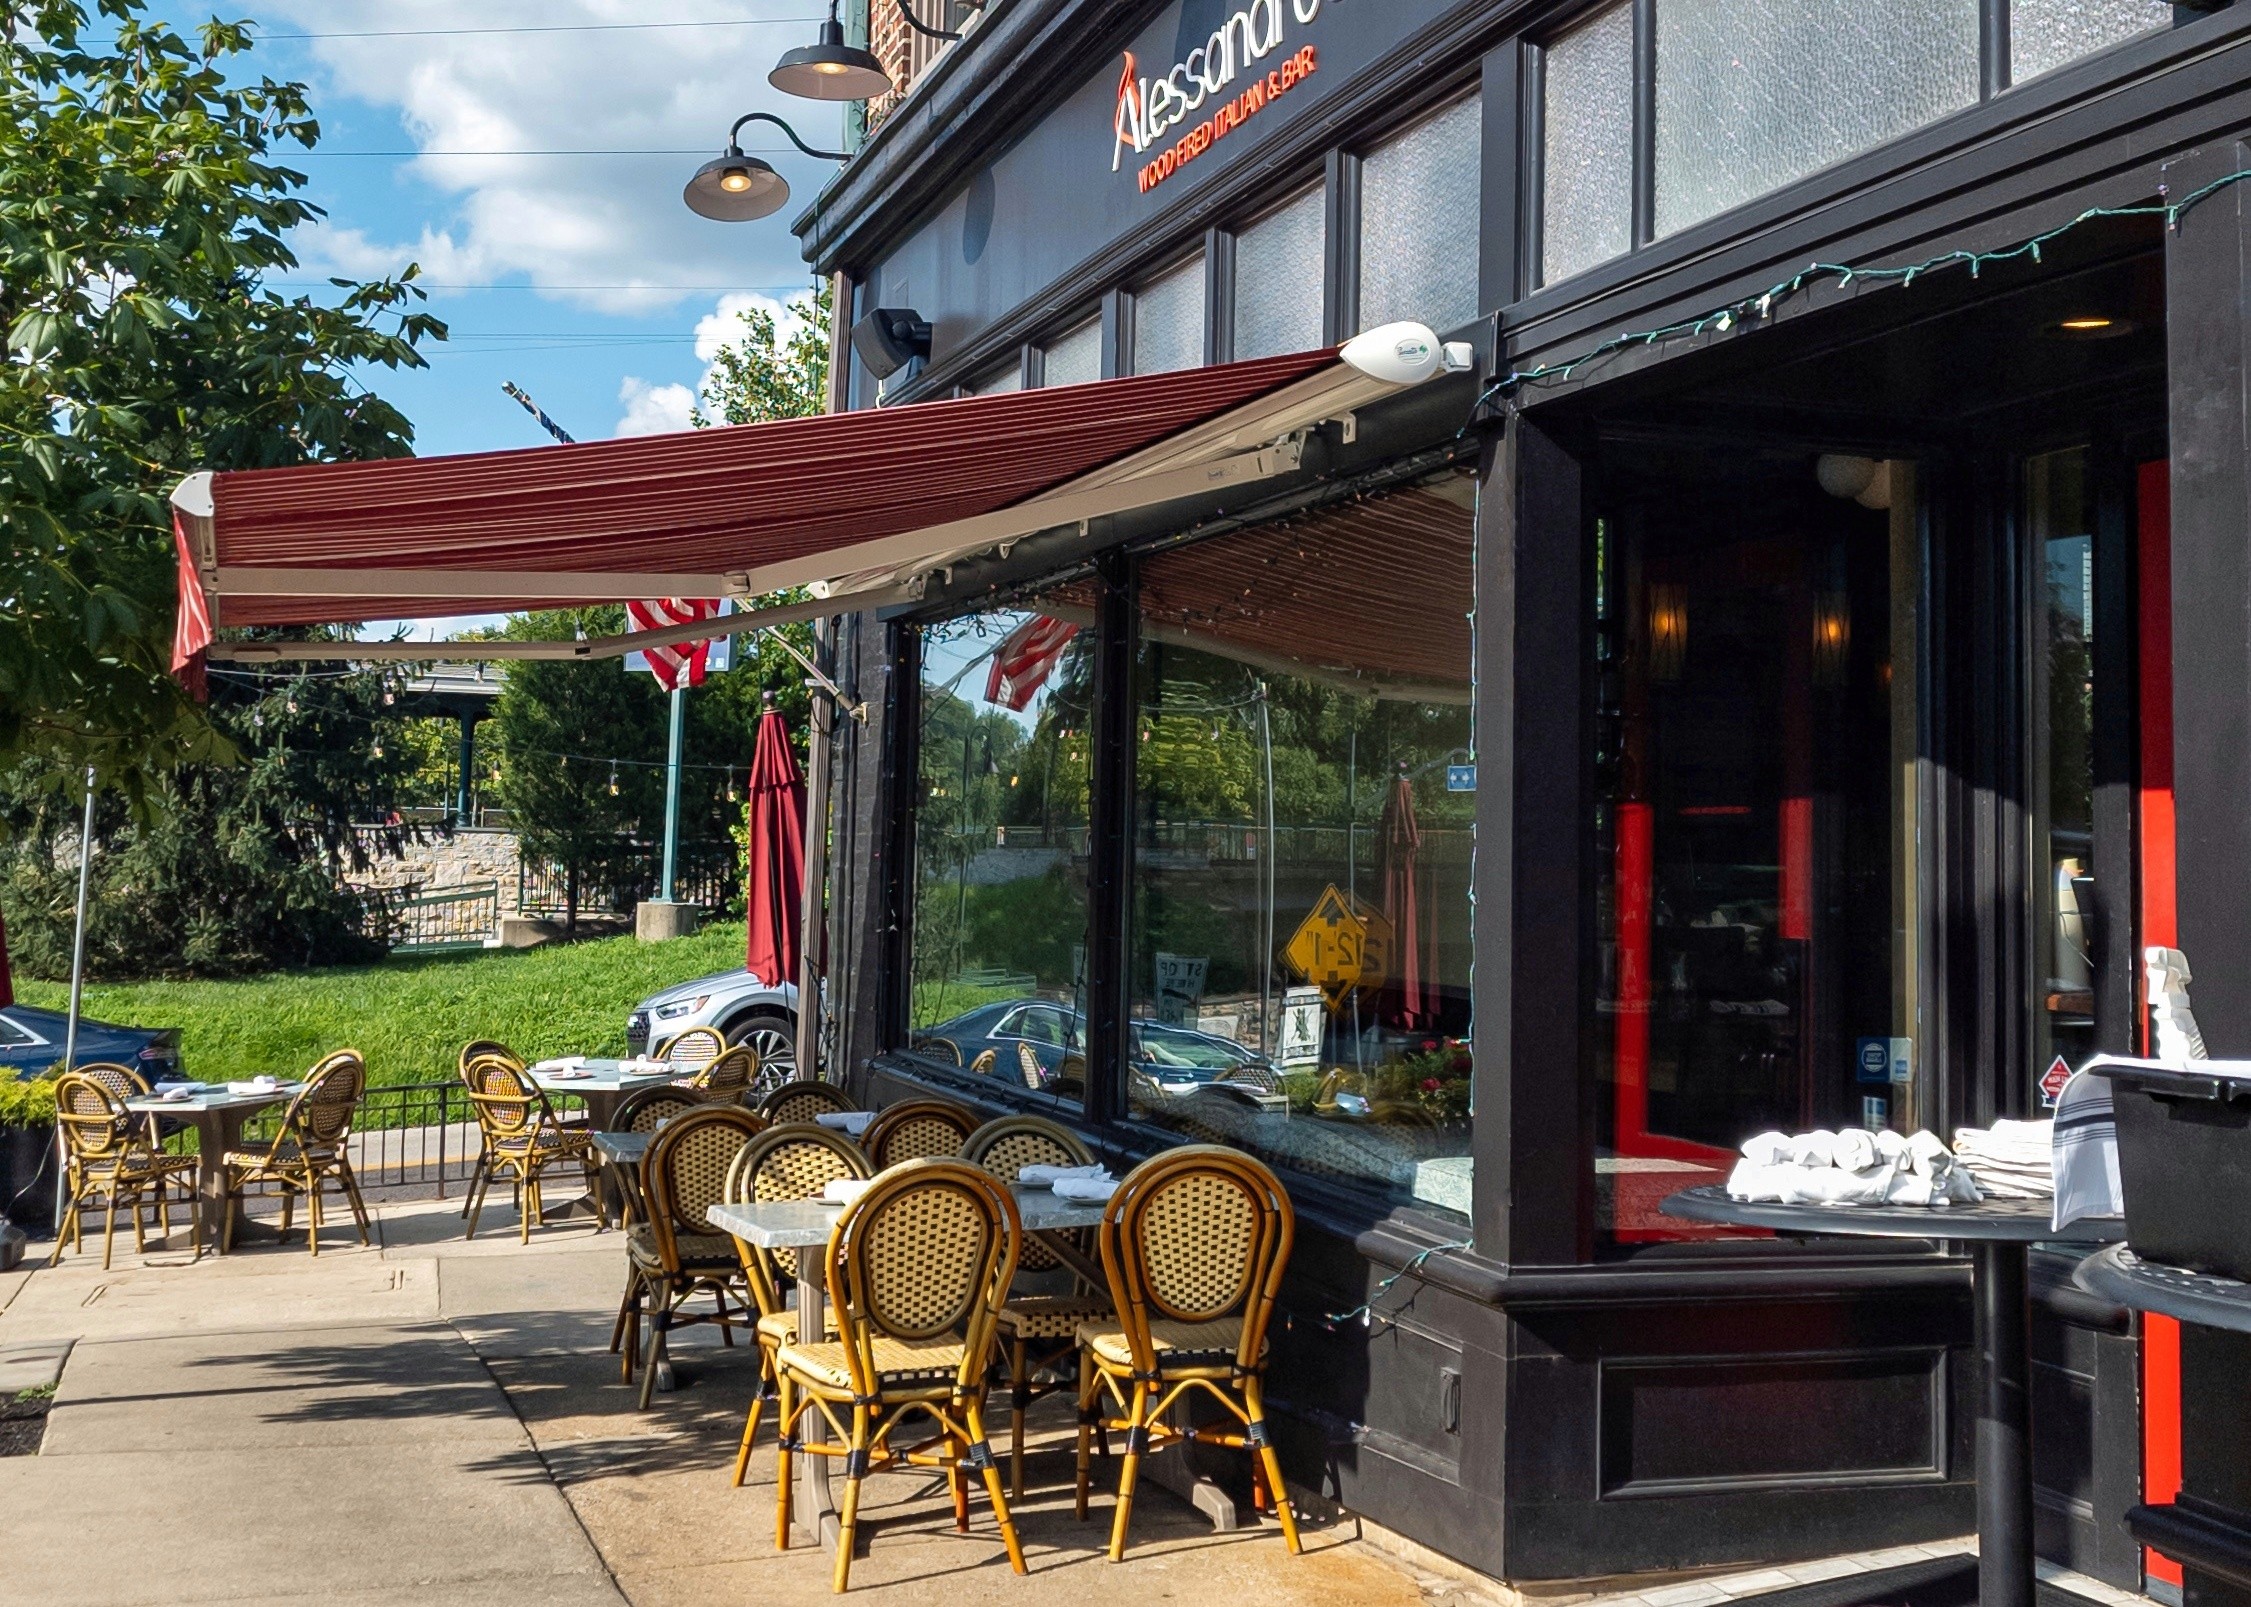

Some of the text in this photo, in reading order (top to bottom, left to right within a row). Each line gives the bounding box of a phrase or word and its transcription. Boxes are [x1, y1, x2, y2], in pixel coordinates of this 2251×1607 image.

[1138, 45, 1316, 193] WOOD FIRED ITALIAN & BAR
